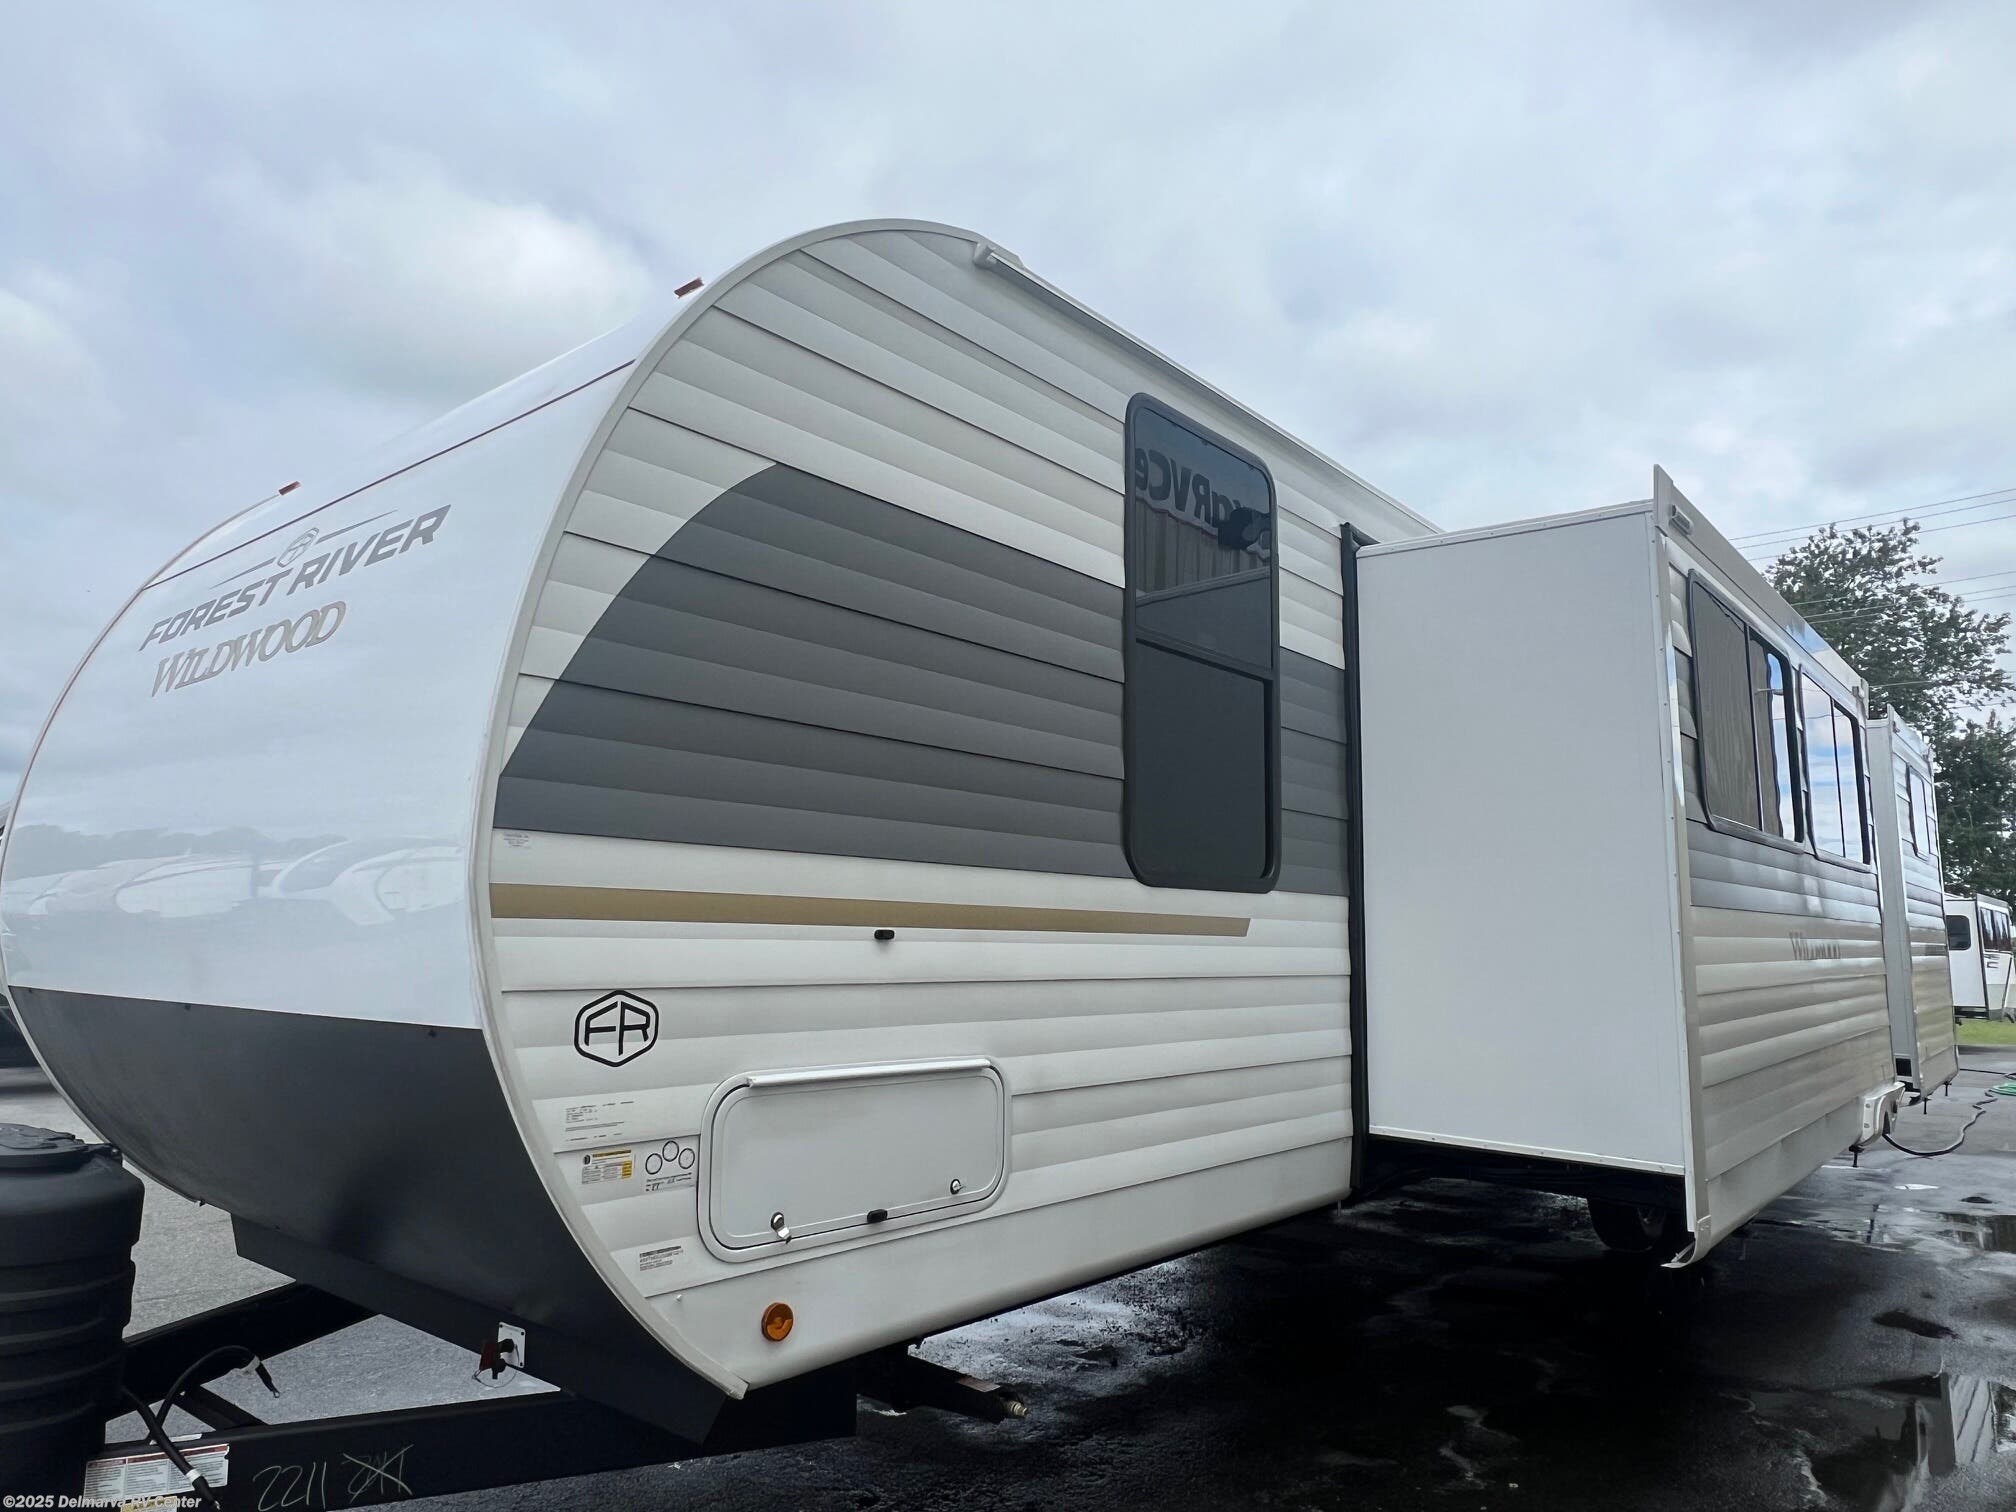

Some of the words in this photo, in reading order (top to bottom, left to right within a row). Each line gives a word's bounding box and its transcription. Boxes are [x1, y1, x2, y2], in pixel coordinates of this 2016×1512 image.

[138, 567, 294, 652] FOREST
[286, 504, 452, 596] RIVER
[151, 600, 347, 697] WILDWOOD
[252, 1461, 328, 1512] 2211
